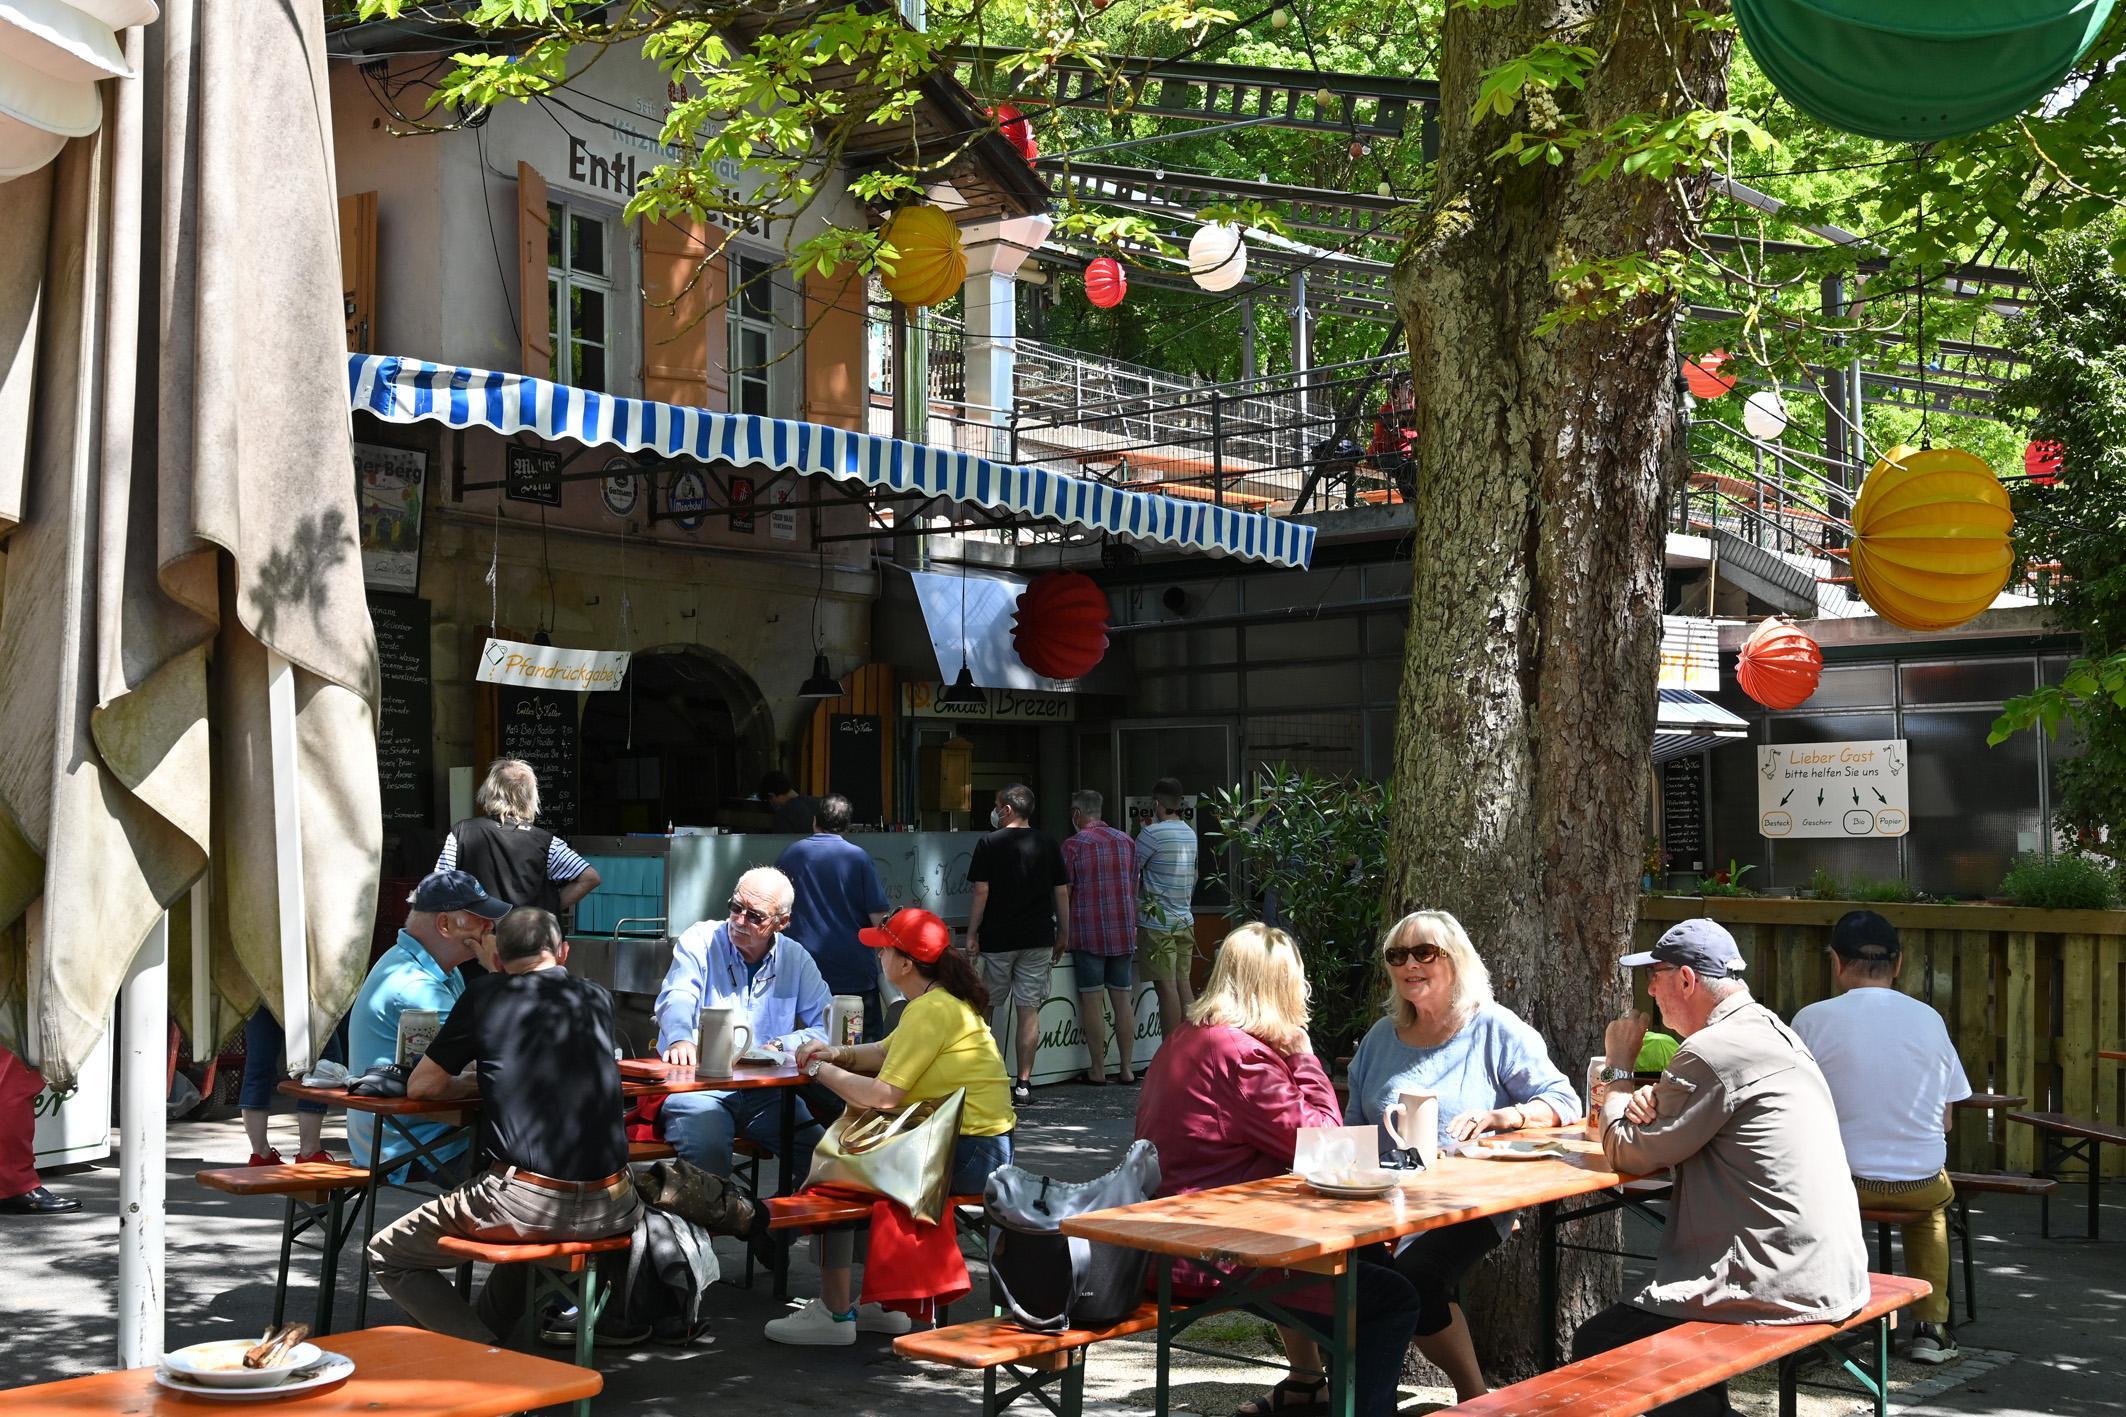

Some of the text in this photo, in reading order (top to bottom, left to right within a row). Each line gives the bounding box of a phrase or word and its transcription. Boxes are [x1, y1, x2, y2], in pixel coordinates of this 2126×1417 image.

[385, 461, 422, 484] Berg
[505, 654, 614, 690] Pfandrückgabe
[996, 689, 1069, 717] Brezen
[1789, 747, 1876, 766] Lieber Gast
[1784, 764, 1880, 780] bitte helfen Sie uns
[1764, 817, 1902, 828] Besteck Geschirr Bio Papier
